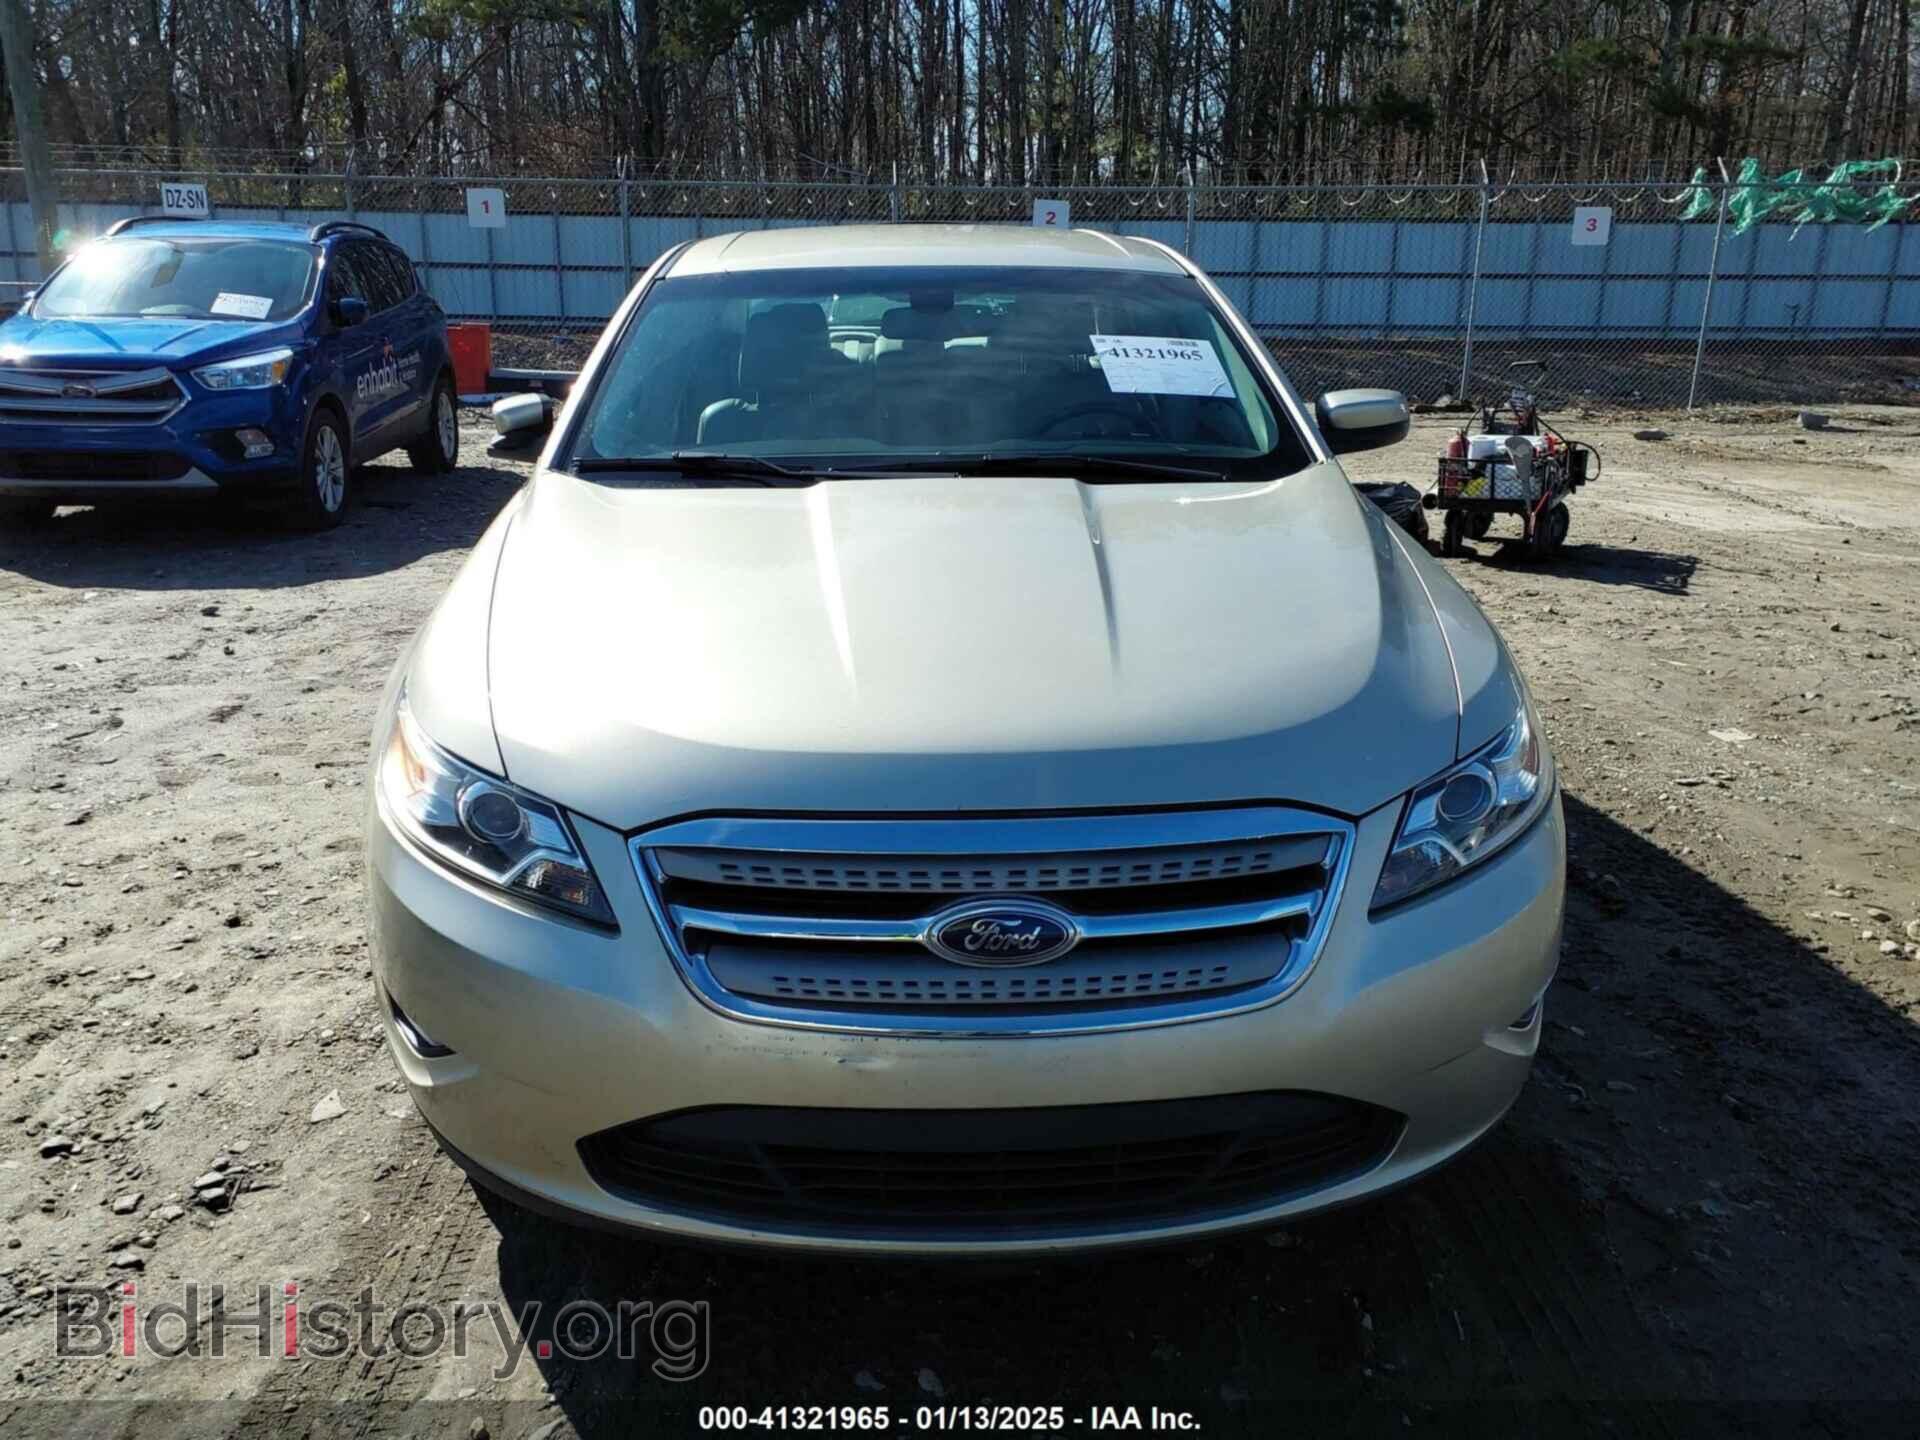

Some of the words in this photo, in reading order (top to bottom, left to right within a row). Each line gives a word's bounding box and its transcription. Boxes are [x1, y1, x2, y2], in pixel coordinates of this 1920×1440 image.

[480, 200, 489, 214] 1
[1045, 211, 1057, 225] 2
[1585, 217, 1597, 232] 3
[1107, 346, 1204, 361] 41321965
[357, 356, 400, 400] enhabit
[964, 918, 1042, 950] Ford
